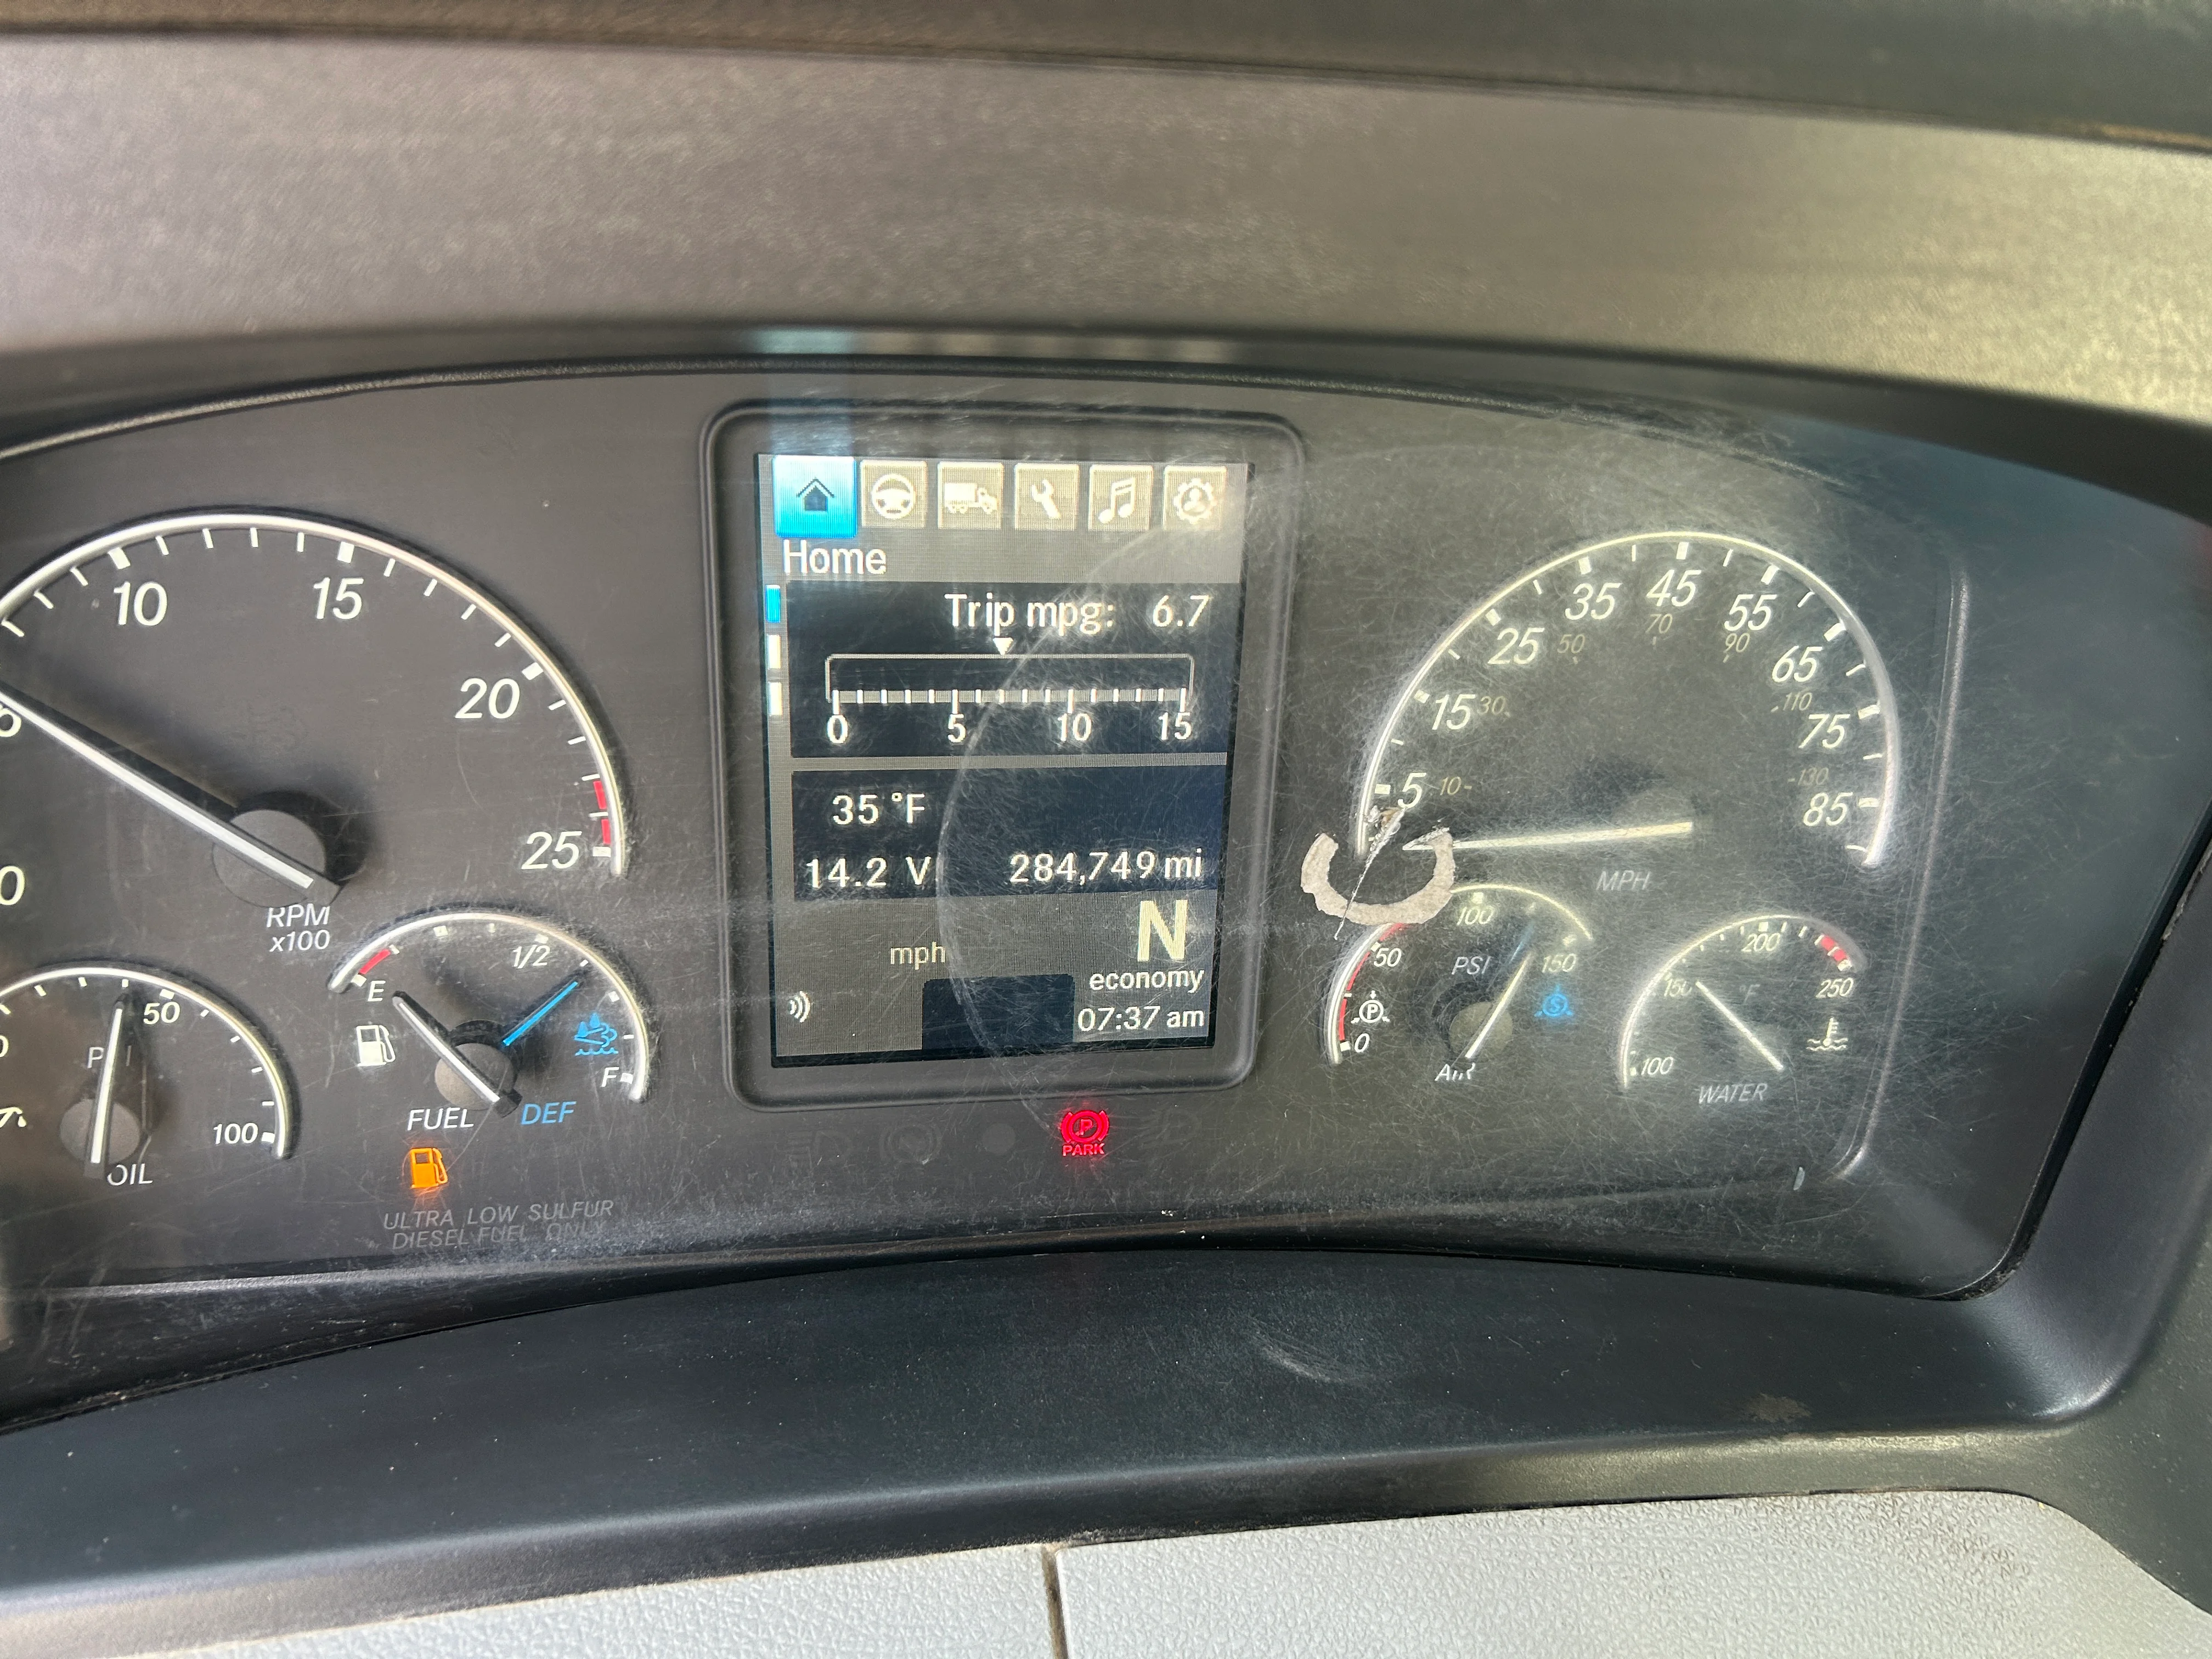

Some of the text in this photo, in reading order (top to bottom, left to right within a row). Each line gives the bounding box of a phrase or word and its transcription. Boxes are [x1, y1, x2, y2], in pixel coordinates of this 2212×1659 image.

[783, 540, 887, 575] Home
[313, 577, 364, 620] 15
[1646, 569, 1701, 606] 45
[113, 582, 167, 625] 10
[1565, 583, 1621, 620] 35
[1724, 594, 1776, 631] 55
[945, 592, 1210, 637] Trip mpg: 6.7
[1647, 614, 1672, 634] 70
[1488, 628, 1544, 665] 25
[1557, 634, 1585, 654] 50
[1725, 633, 1750, 654] 90
[1772, 646, 1822, 682] 65
[455, 678, 520, 719] 20
[1479, 696, 1505, 714] 30
[1431, 694, 1475, 730] 15
[826, 713, 848, 744] 0
[947, 713, 966, 744] 5
[1057, 712, 1092, 742] 10
[1159, 712, 1192, 741] 15
[1799, 714, 1850, 749] 75
[1398, 772, 1426, 808] 5
[1440, 776, 1461, 795] 10
[833, 792, 926, 826] 35 °F
[1803, 792, 1853, 826] 85
[521, 831, 582, 870] 25
[806, 855, 930, 889] 14.2 V
[1010, 848, 1202, 885] 284,749 mi
[1596, 871, 1651, 891] MPH
[267, 903, 330, 927] RPM
[1457, 907, 1493, 926] 100
[269, 929, 330, 952] x100
[1137, 899, 1187, 963] N
[1742, 934, 1781, 952] 200
[512, 945, 551, 969] 1/2
[890, 942, 945, 970] mph
[1373, 947, 1401, 967] 50
[1452, 956, 1491, 975] PSI
[1542, 953, 1577, 972] 150
[368, 981, 385, 1002] E
[1089, 969, 1204, 994] economy
[1815, 978, 1854, 998] 250
[143, 1002, 180, 1024] 50
[1079, 1005, 1204, 1032] 07:37 am
[1353, 1034, 1370, 1053] 0
[87, 1045, 131, 1068] PI
[1641, 1057, 1674, 1075] 100
[601, 1067, 619, 1087] F
[1699, 1083, 1768, 1104] WATER
[407, 1107, 474, 1131] FUEL
[521, 1101, 577, 1125] DEF
[213, 1123, 258, 1144] 100
[1062, 1143, 1104, 1156] PARK
[107, 1163, 153, 1186] OIL
[384, 1200, 614, 1229] ULTRA LOW SULFUR
[392, 1229, 469, 1250] DIESEL
[477, 1225, 527, 1243] FUEL
